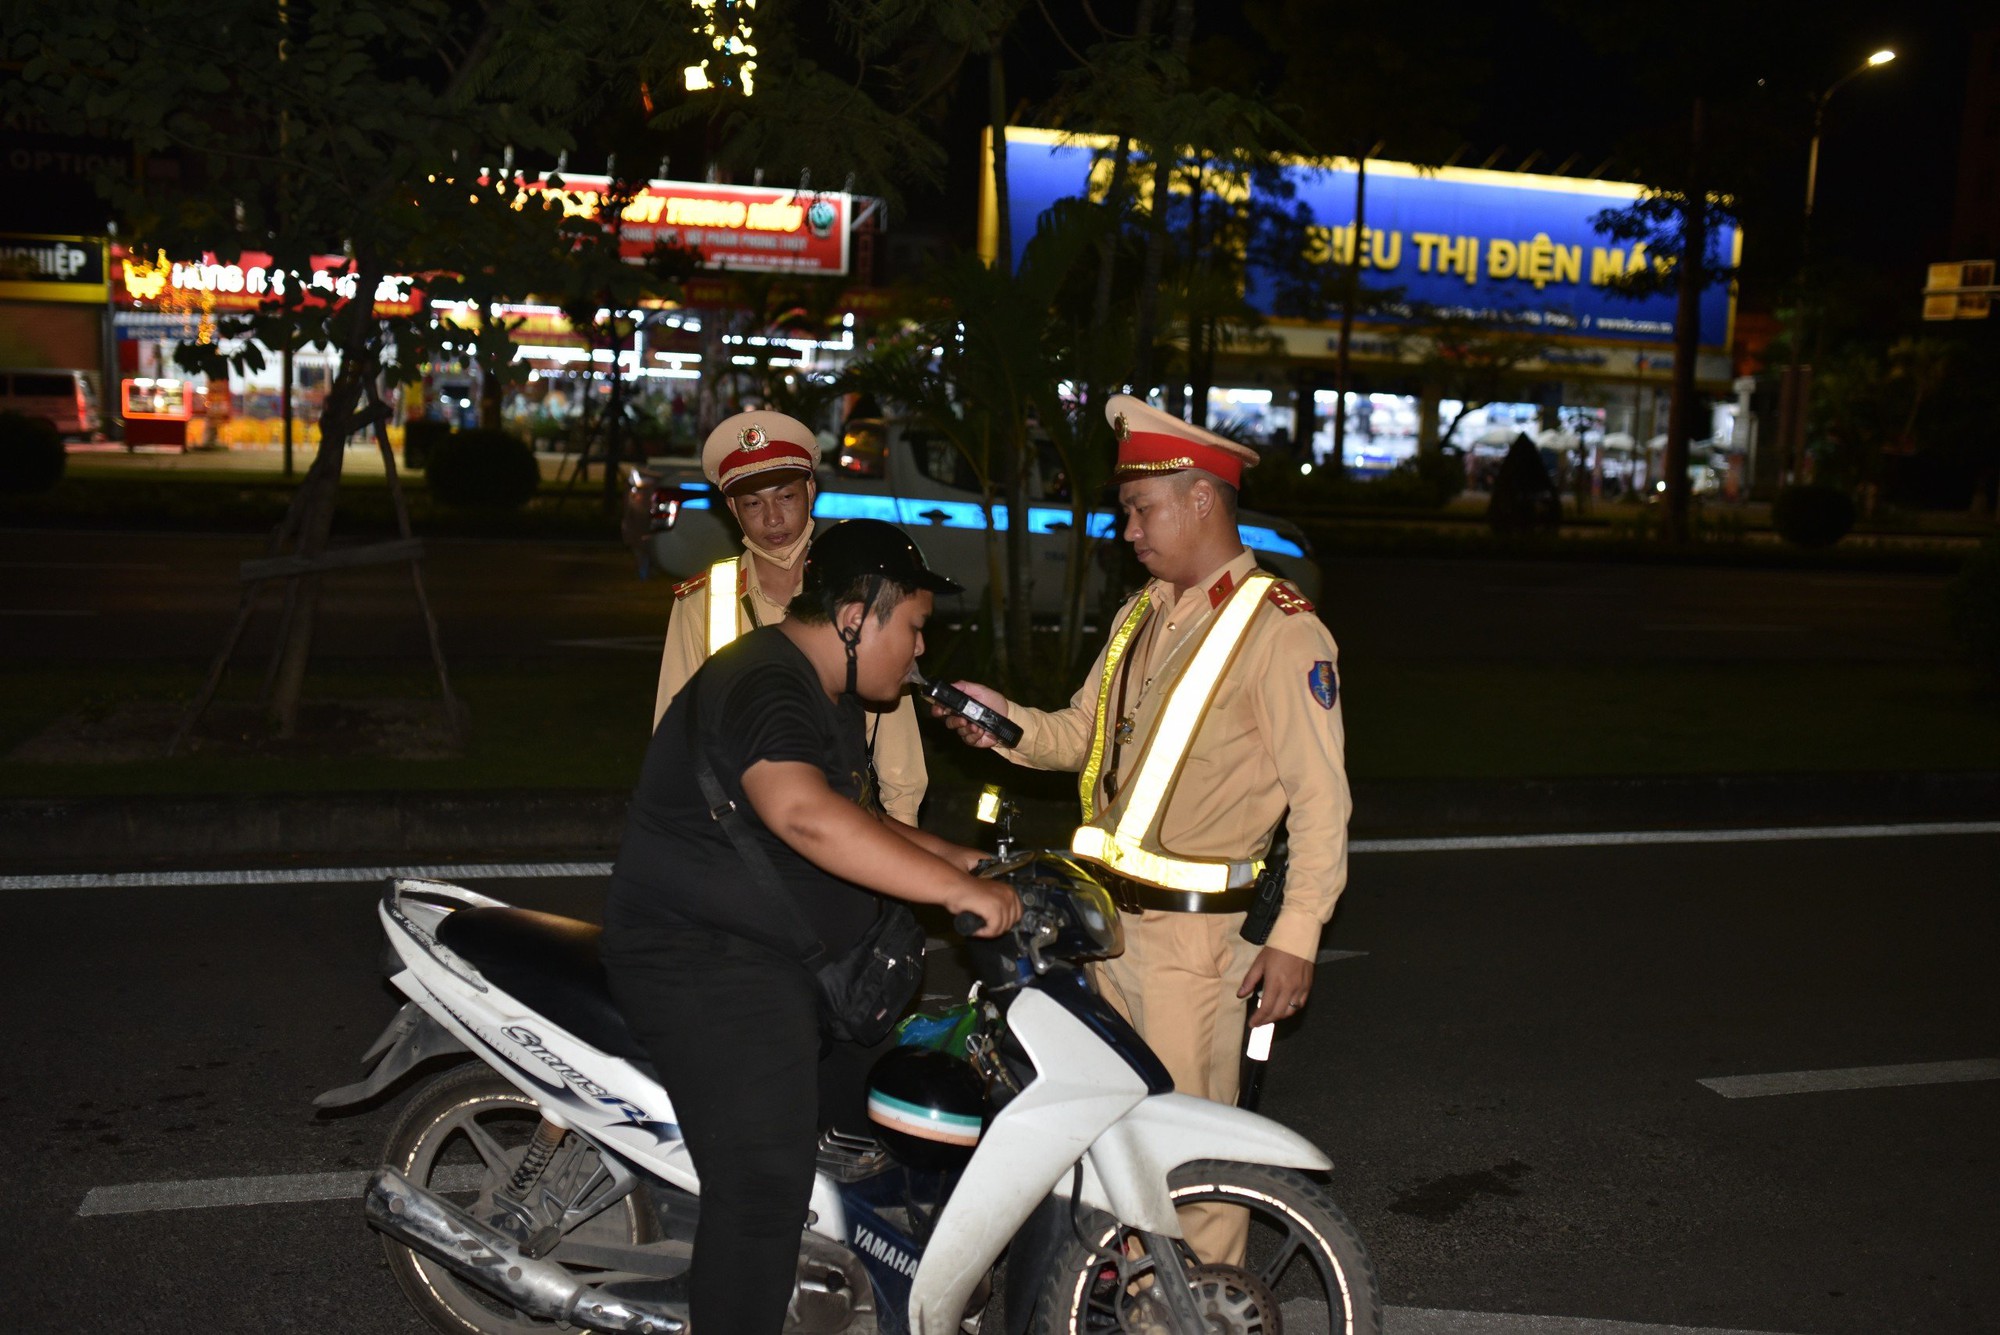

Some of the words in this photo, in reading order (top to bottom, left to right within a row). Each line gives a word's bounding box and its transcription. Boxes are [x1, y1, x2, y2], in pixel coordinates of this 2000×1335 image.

[1302, 220, 1403, 271] SIÊU
[1412, 231, 1479, 285] THỊ
[1485, 232, 1583, 290] ĐIỆN
[853, 1223, 919, 1280] YAMAHA
